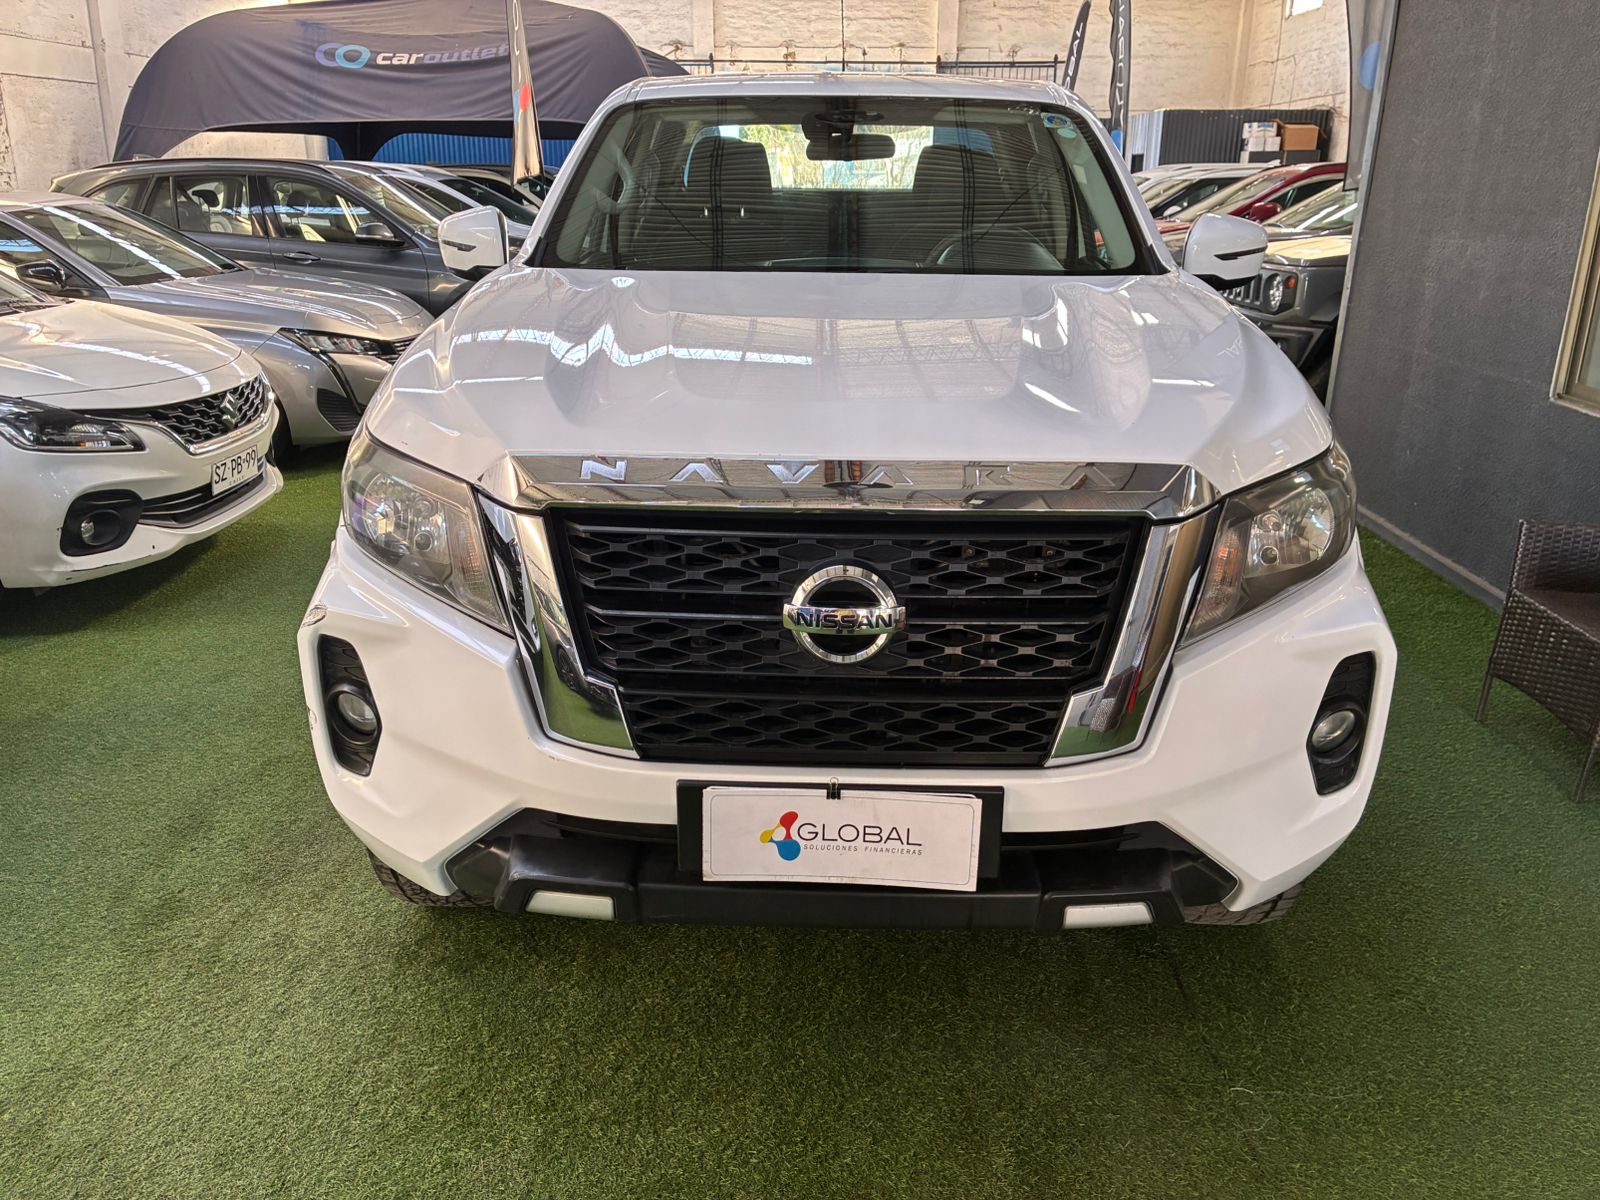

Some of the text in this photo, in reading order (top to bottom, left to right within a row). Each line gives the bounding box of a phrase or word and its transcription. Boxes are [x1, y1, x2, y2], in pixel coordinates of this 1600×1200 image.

[579, 458, 1117, 489] NAVARA
[796, 612, 893, 629] NISSAN
[797, 822, 922, 846] GLOBAL
[803, 843, 923, 856] SOLUCIONES FINANCIERAS
